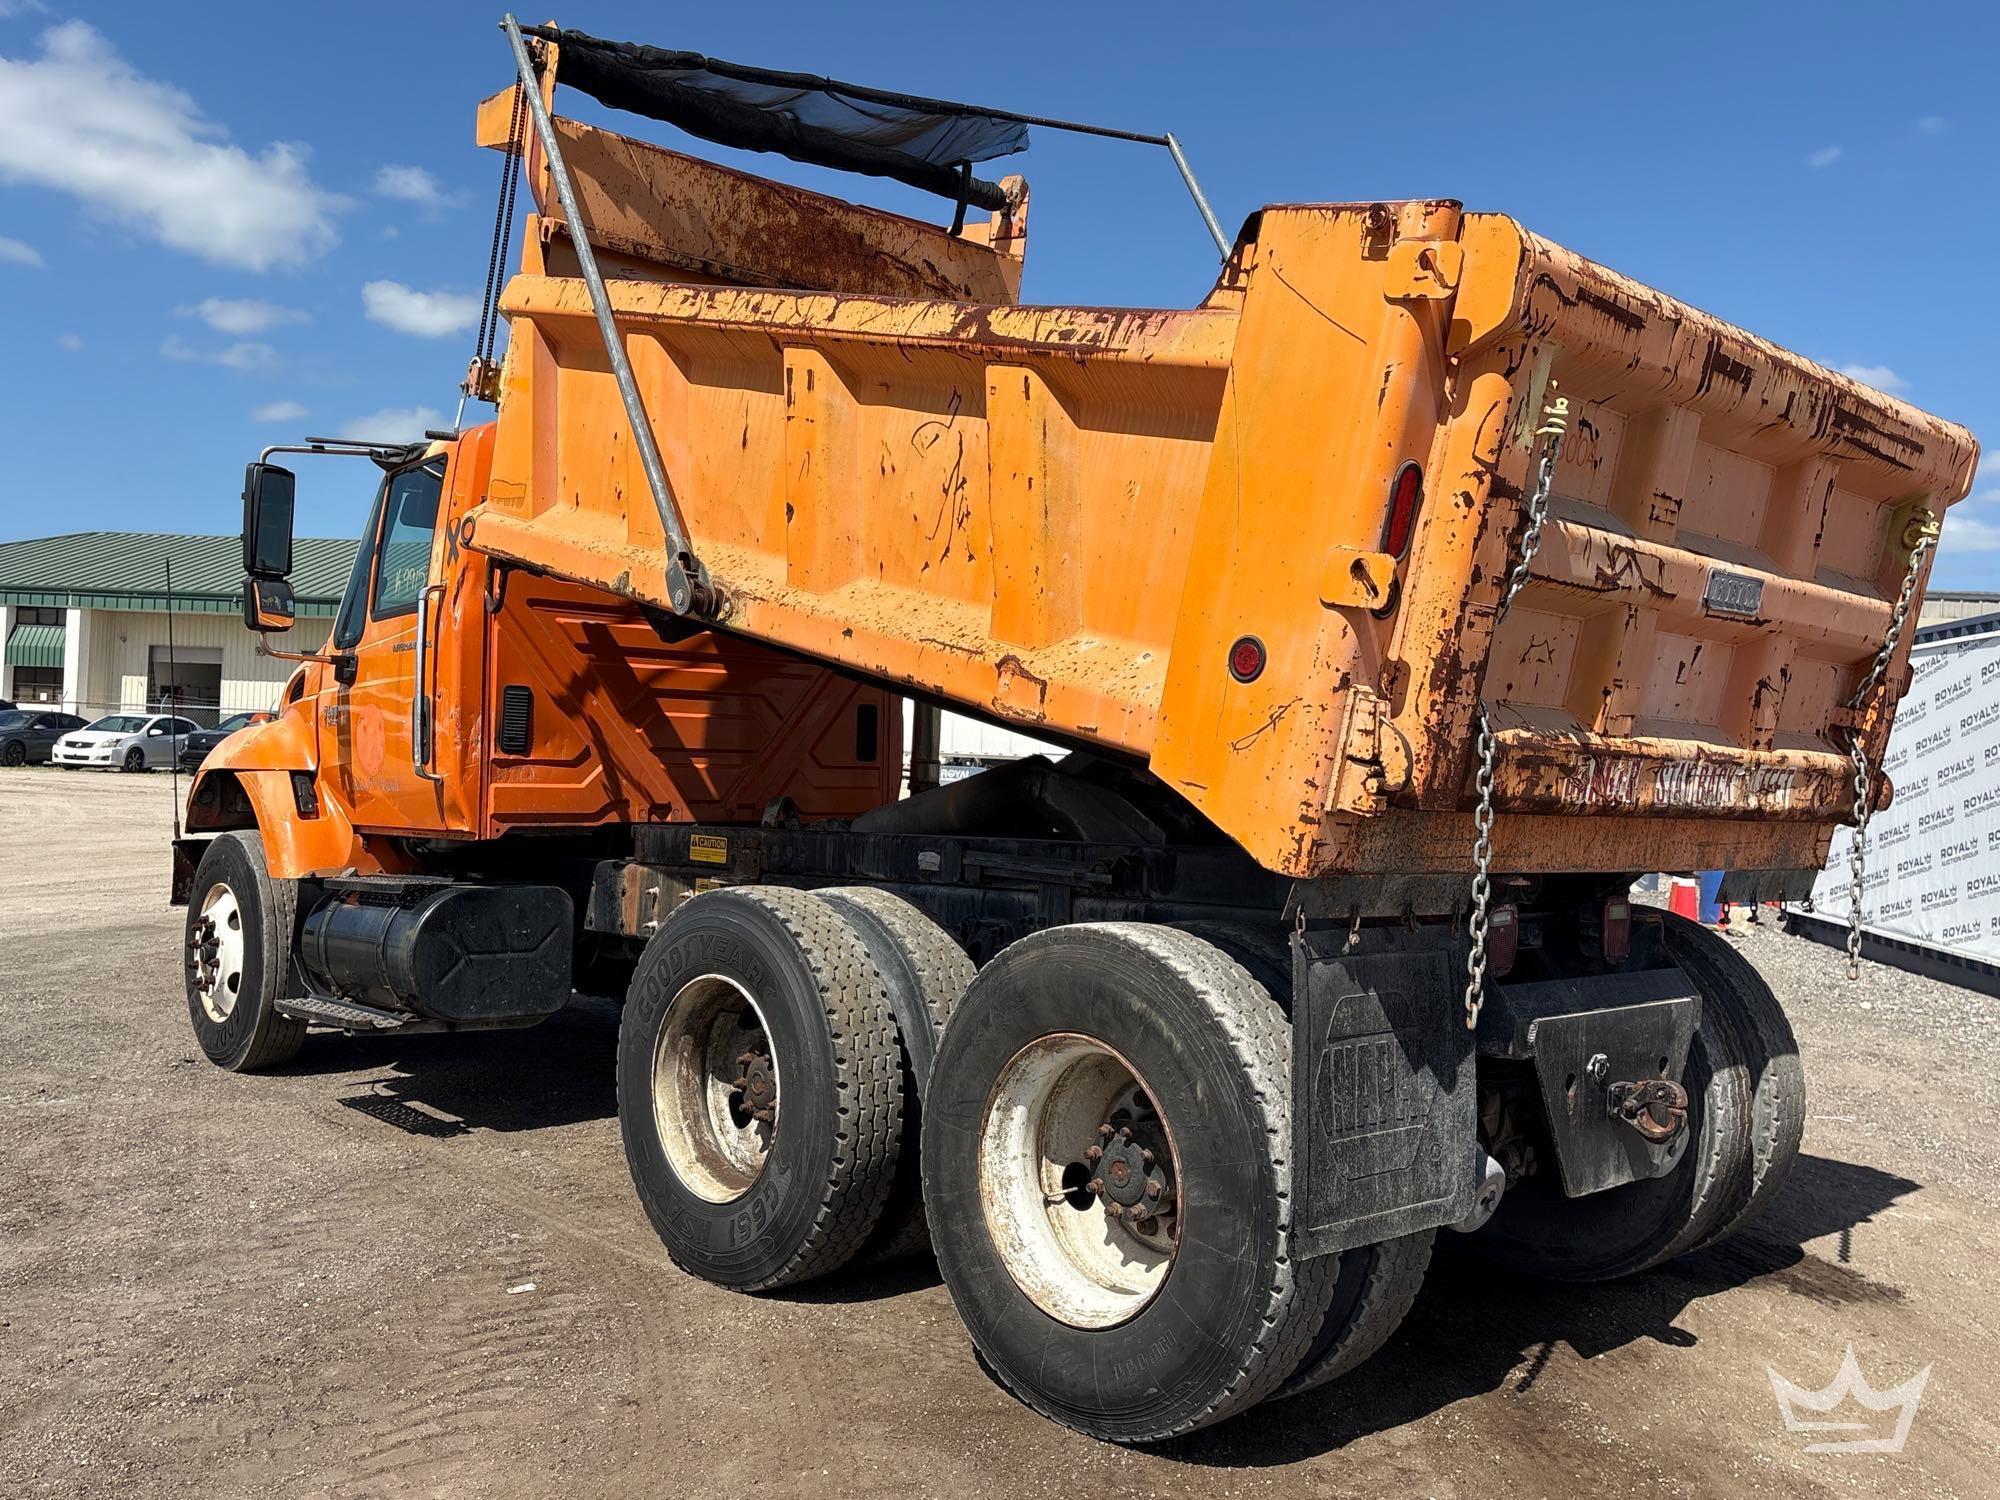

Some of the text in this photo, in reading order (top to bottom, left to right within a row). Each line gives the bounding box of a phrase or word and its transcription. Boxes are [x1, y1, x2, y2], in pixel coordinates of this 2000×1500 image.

[1914, 654, 1941, 676] ROYAL
[1935, 680, 1963, 704] ROYAL
[1960, 706, 1991, 730] ROYAL
[1915, 730, 1943, 752] ROYAL
[1938, 760, 1967, 781] ROYAL
[1895, 779, 1921, 799] ROYAL
[1963, 790, 1994, 810] ROYAL
[1918, 809, 1946, 827] ROYAL
[1879, 825, 1903, 842] ROYAL
[699, 838, 726, 848] CAUTION
[1941, 841, 1970, 859] ROYAL
[1897, 856, 1924, 873] ROYAL
[1967, 875, 1998, 892] ROYAL
[1921, 888, 1949, 904] ROYAL
[1880, 900, 1905, 915] ROYAL
[1943, 924, 1973, 939] ROYAL
